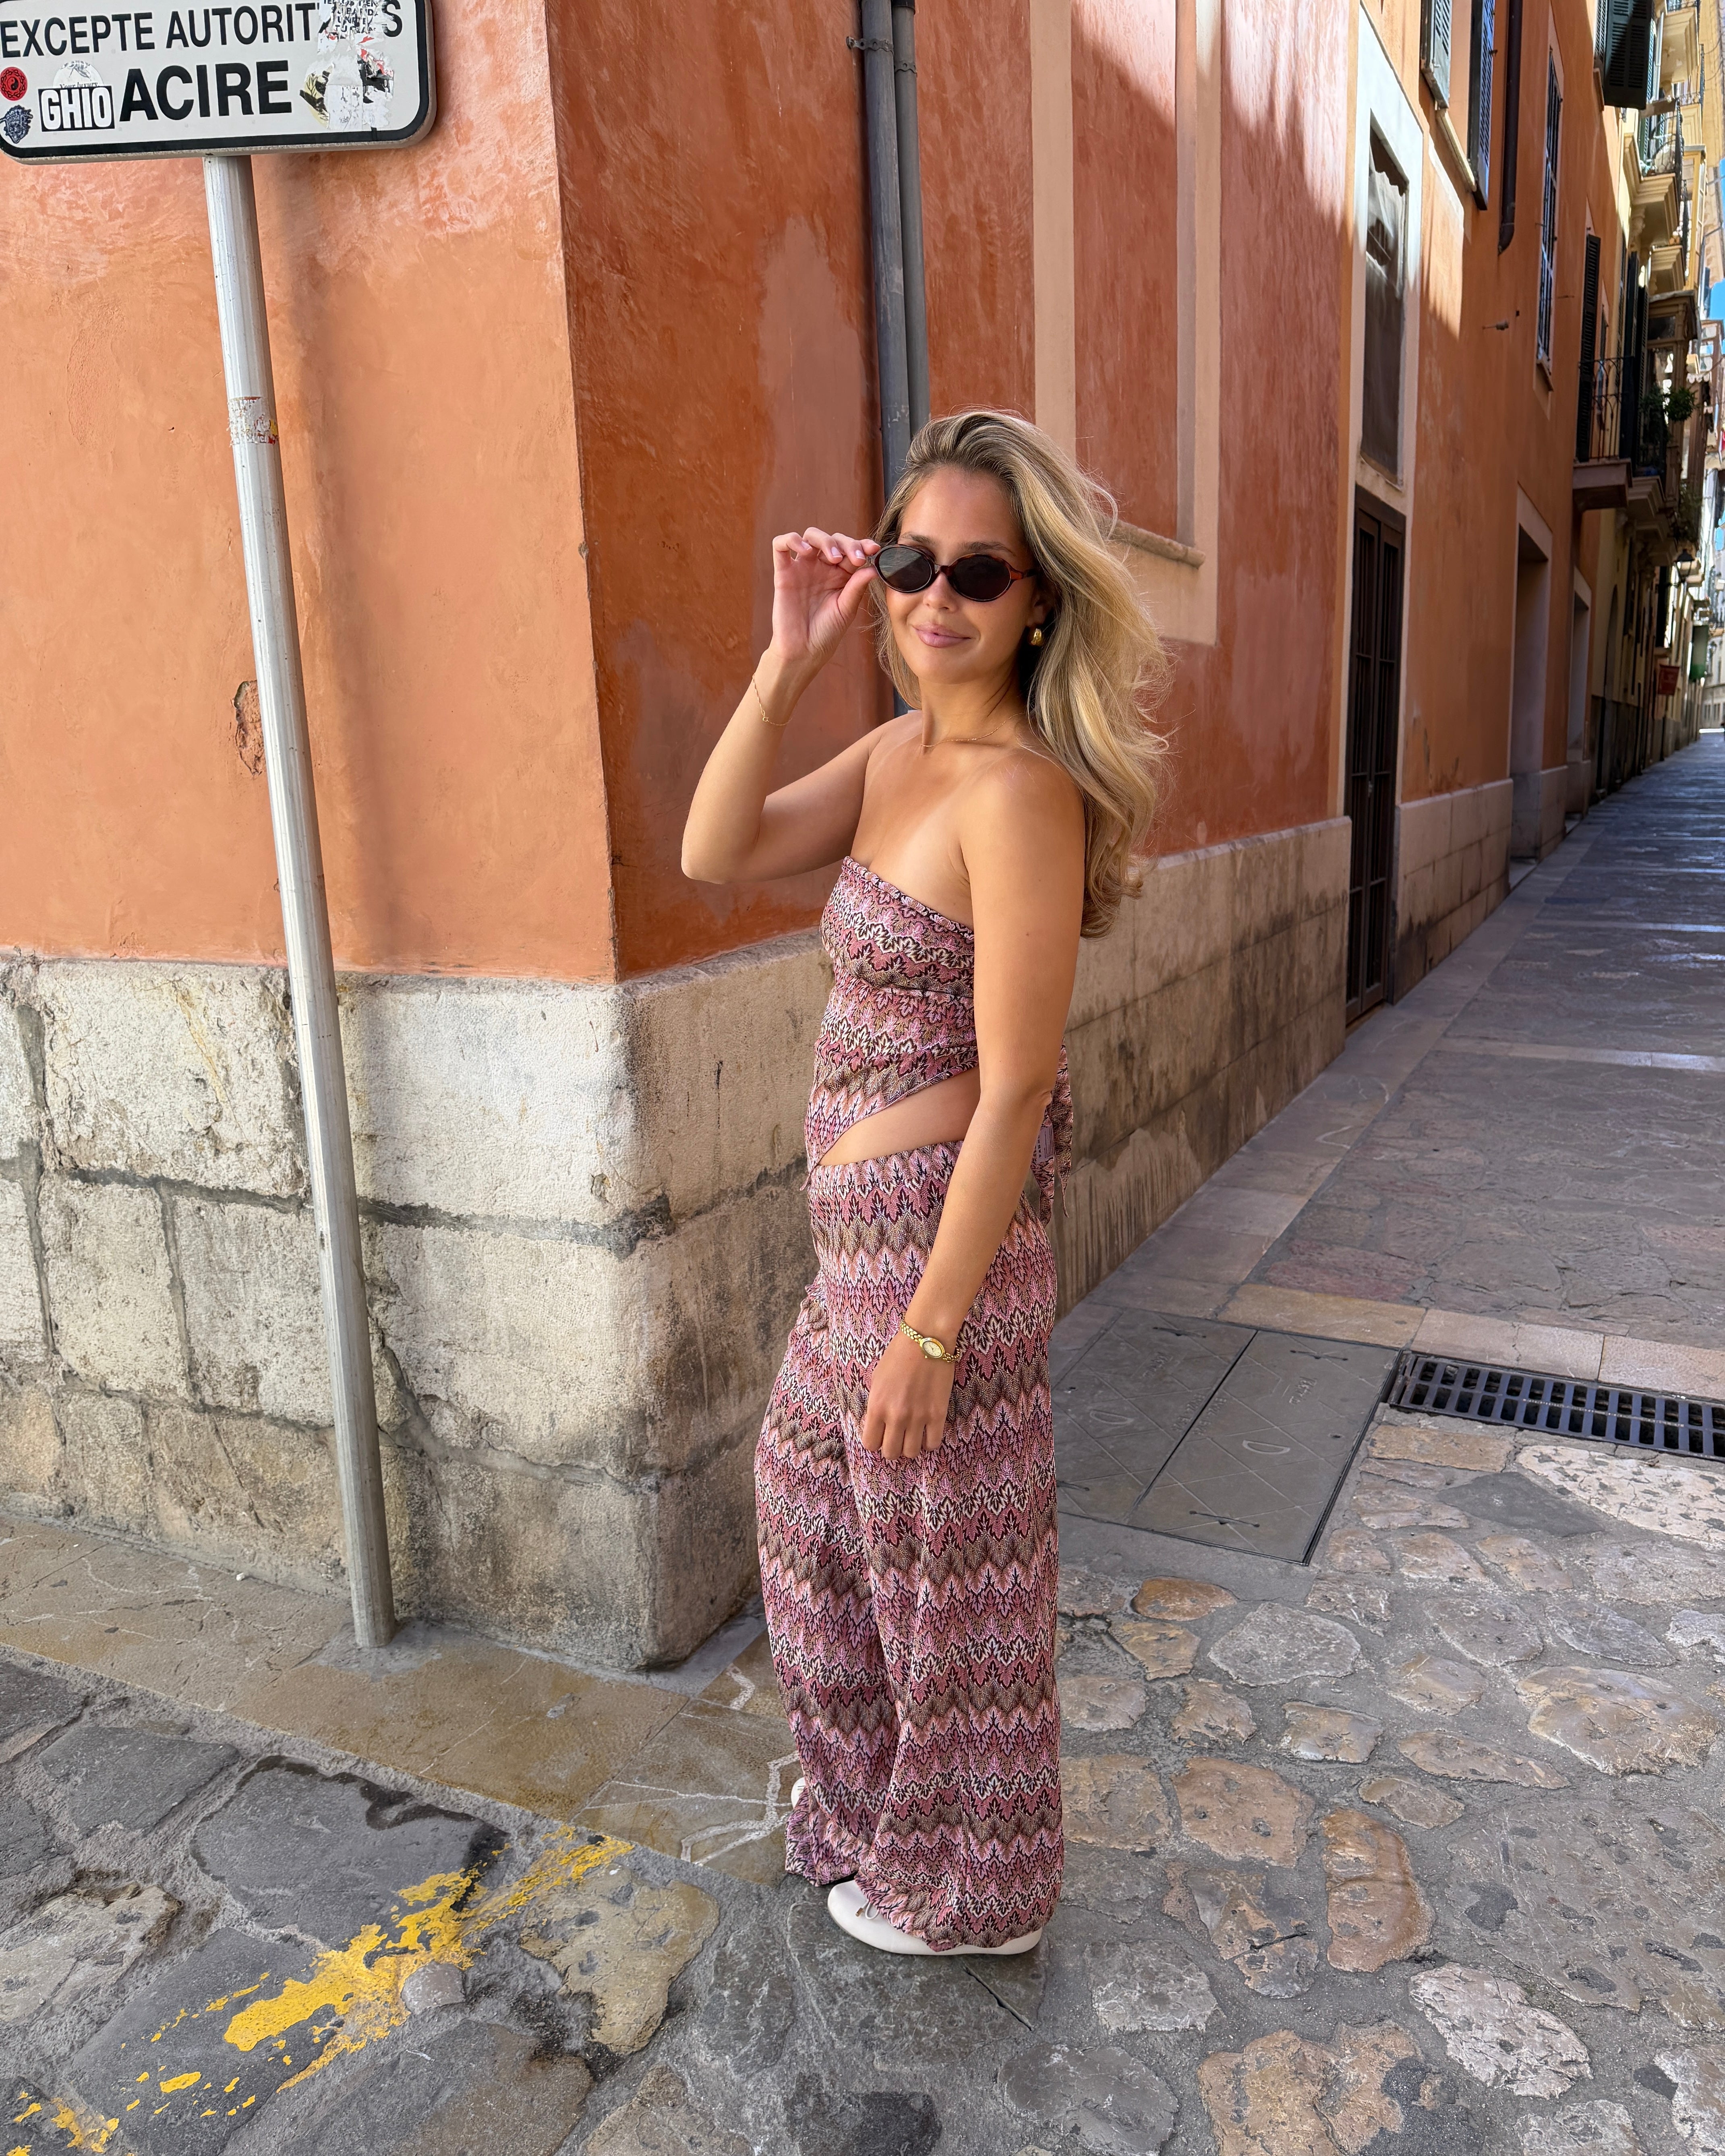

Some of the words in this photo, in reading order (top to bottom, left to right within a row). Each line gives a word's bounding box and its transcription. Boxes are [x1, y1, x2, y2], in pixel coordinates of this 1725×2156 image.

[0, 12, 155, 58] EXCEPTE
[166, 0, 402, 48] AUTORITS
[41, 87, 112, 130] GHIO
[119, 60, 292, 122] ACIRE
